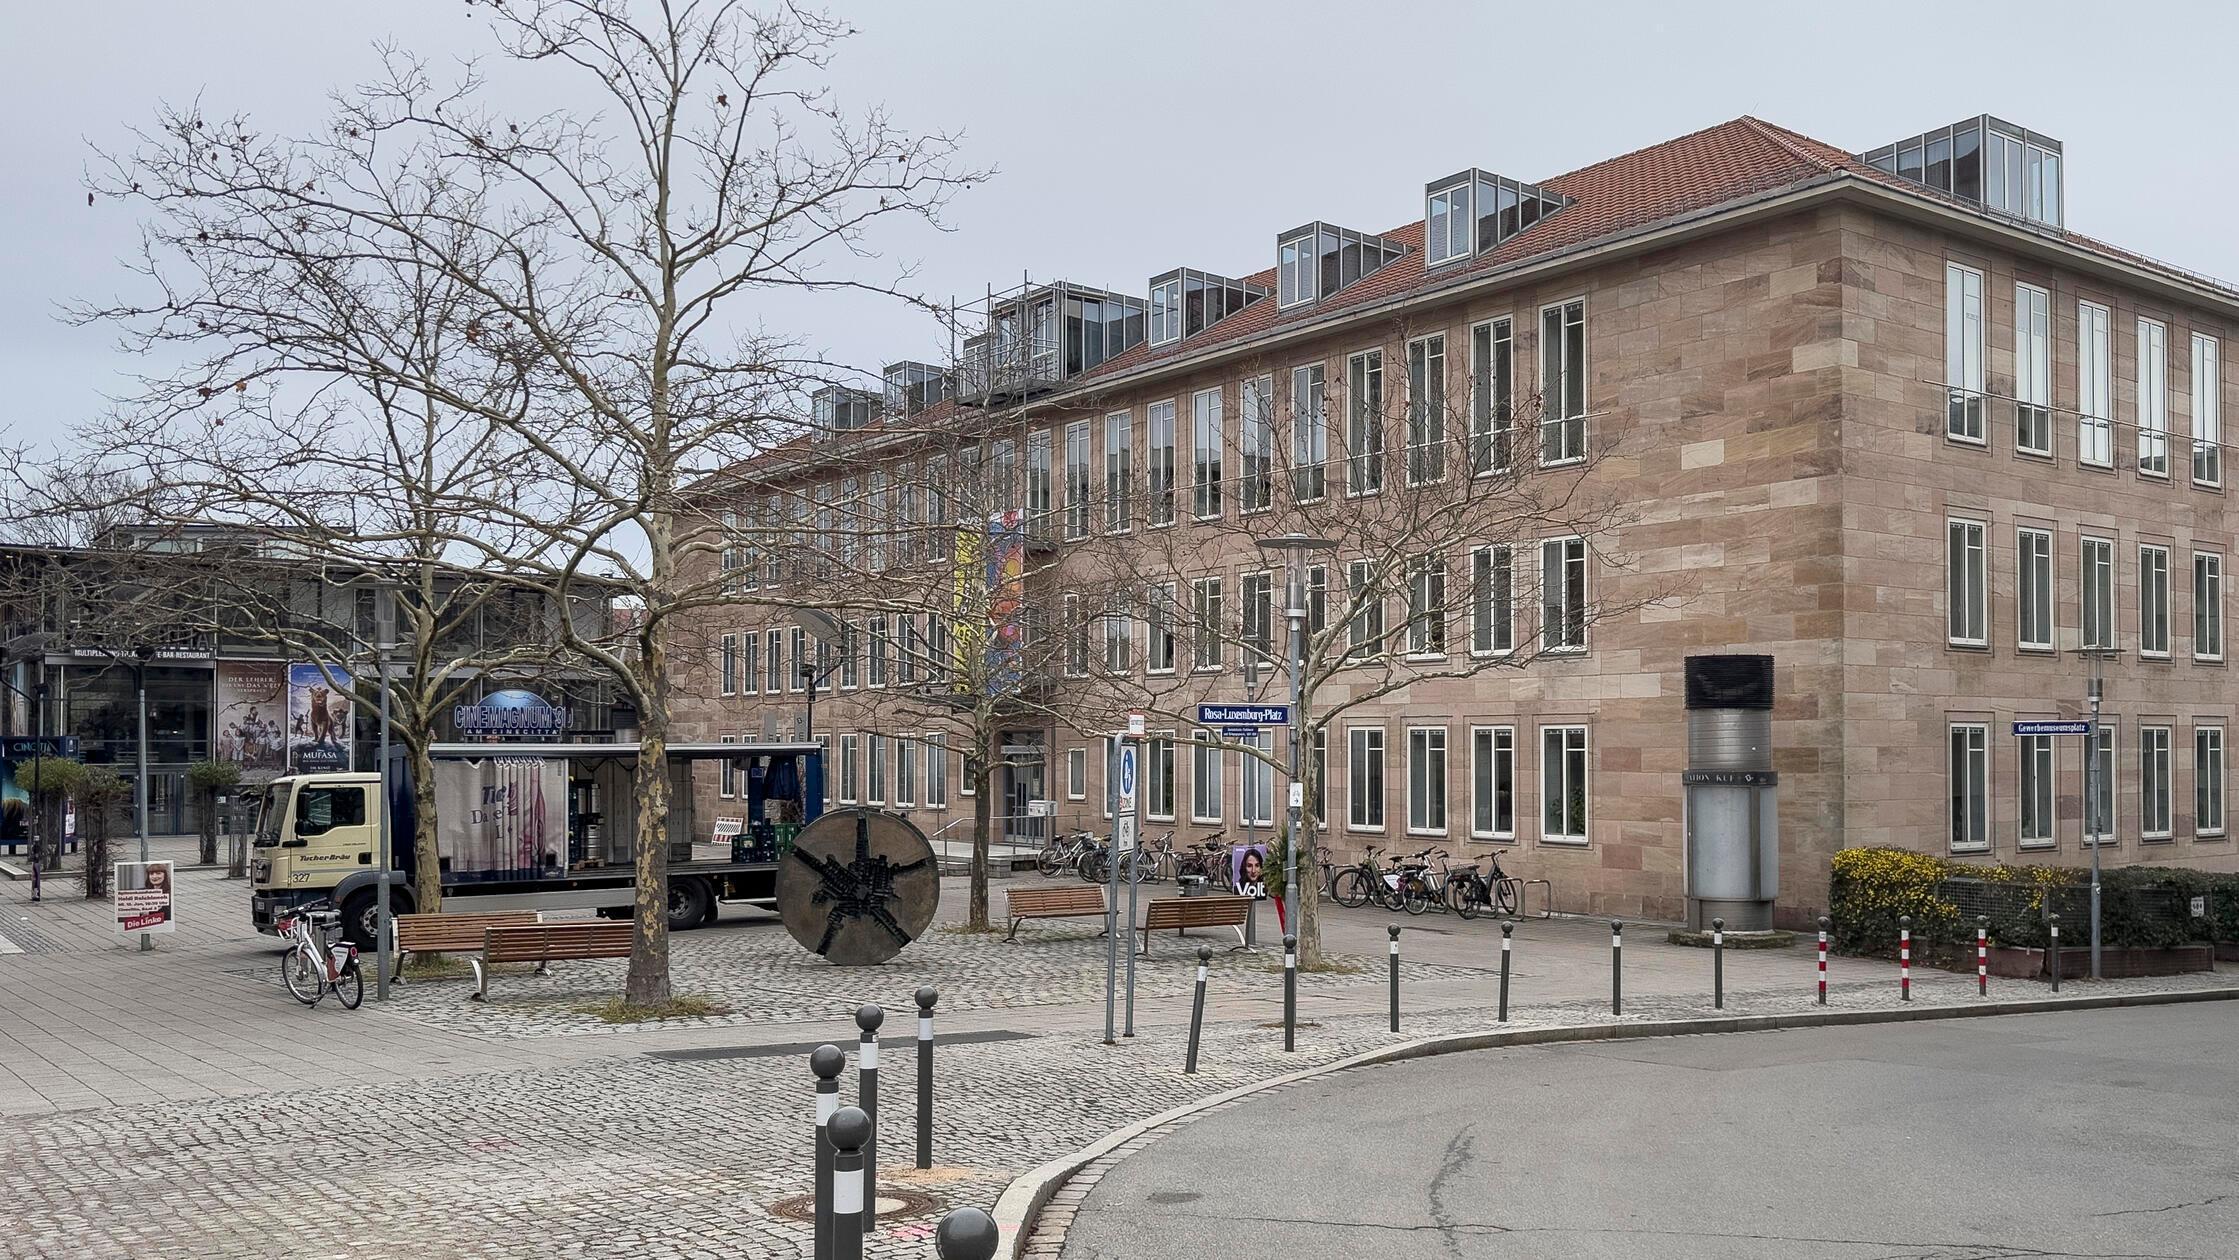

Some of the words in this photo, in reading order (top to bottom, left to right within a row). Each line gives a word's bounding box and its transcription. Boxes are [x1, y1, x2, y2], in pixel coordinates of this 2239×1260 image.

[454, 705, 553, 729] CINEMAGNUM
[1204, 707, 1283, 722] Rosa-Luxemburg-Platz
[2018, 723, 2086, 733] Gewerbemuseumsplatz
[302, 751, 338, 759] MUFASA
[292, 873, 311, 883] 327
[1235, 882, 1266, 897] Volt
[127, 920, 140, 928] Die
[140, 915, 162, 926] Linke
